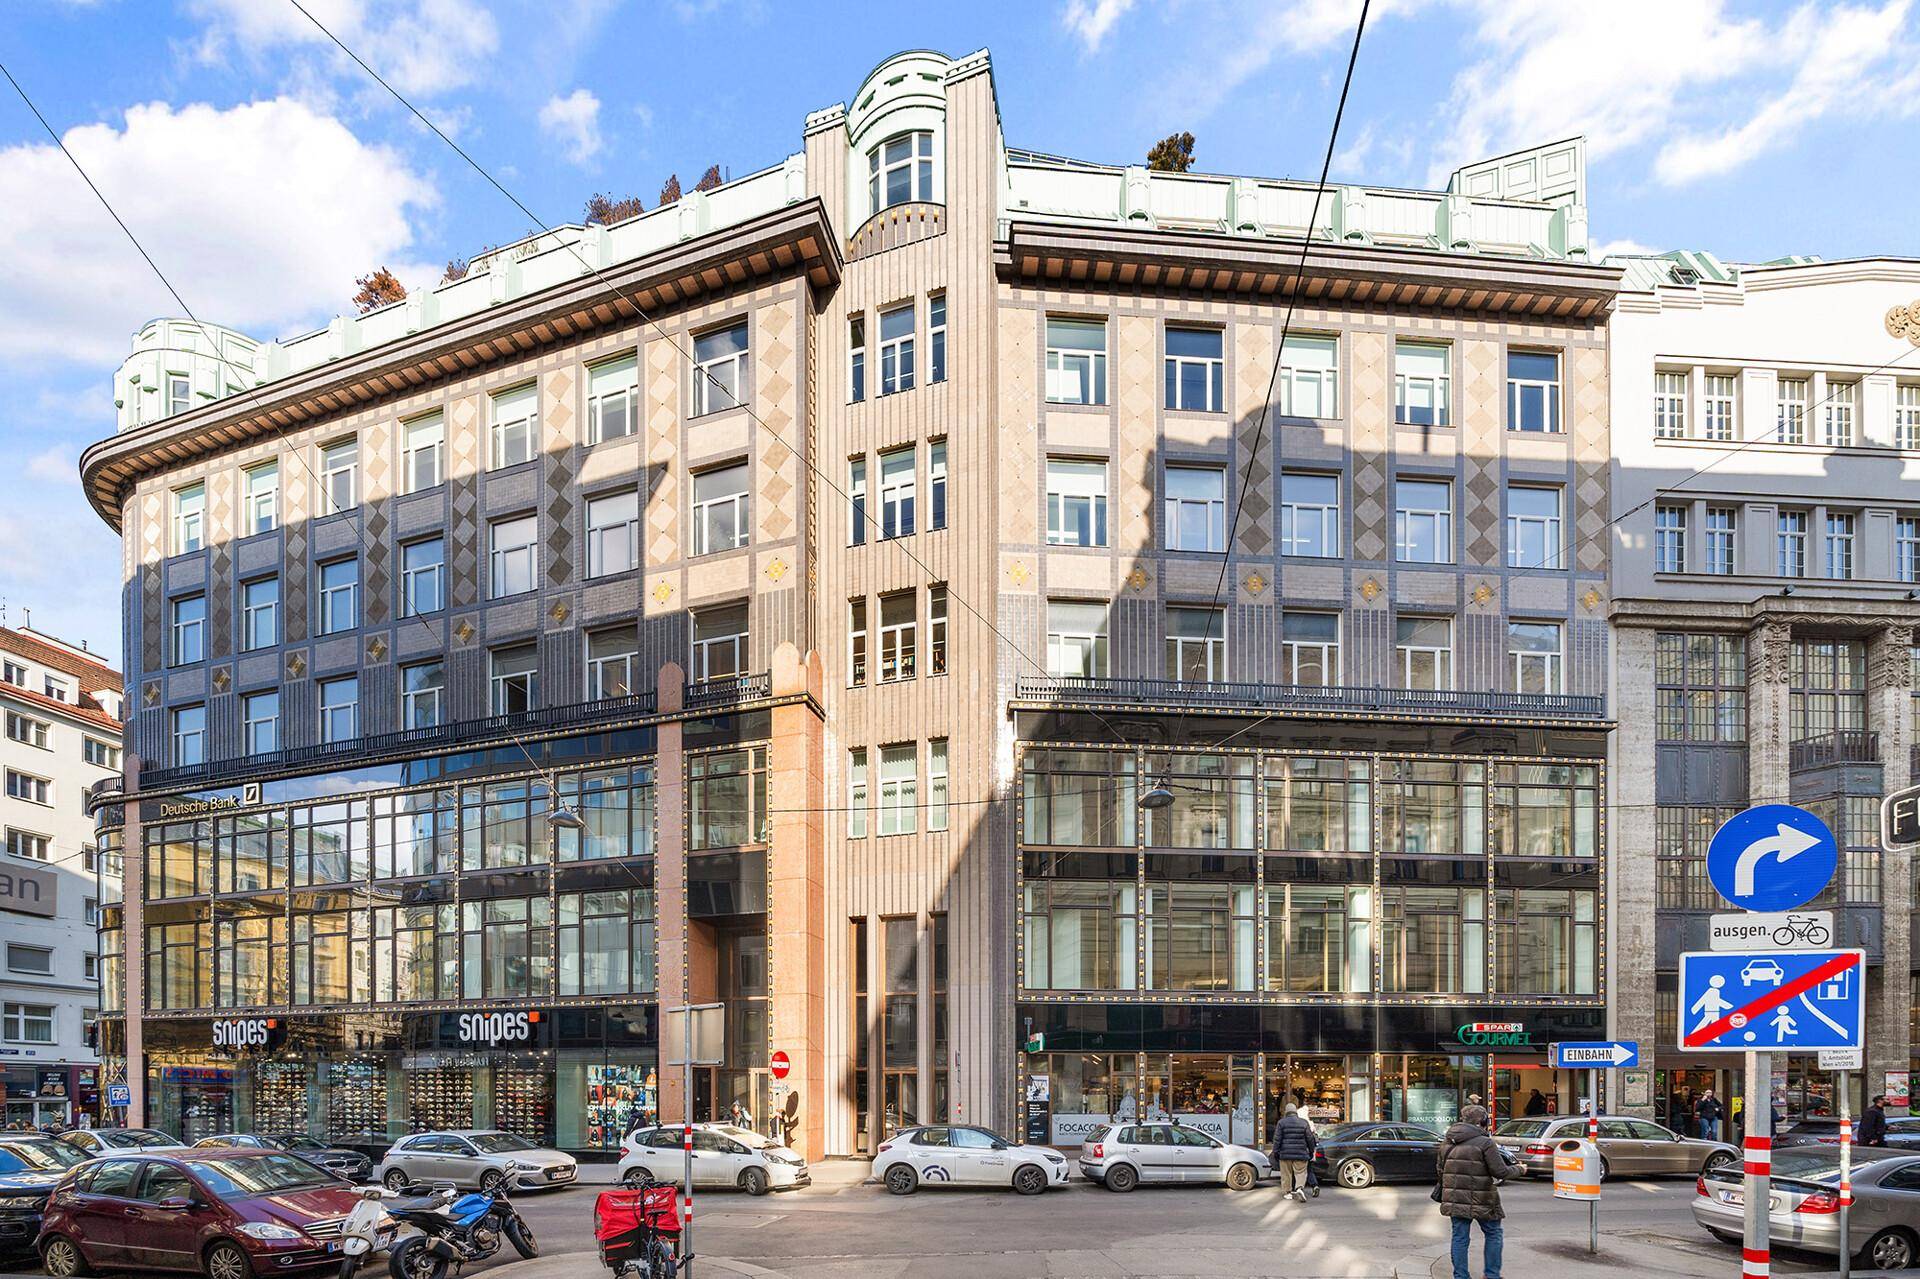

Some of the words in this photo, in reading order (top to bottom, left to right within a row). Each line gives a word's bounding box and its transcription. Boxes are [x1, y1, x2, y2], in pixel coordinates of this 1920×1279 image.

[160, 800, 208, 816] Deutsche
[210, 794, 238, 810] Bank
[1893, 797, 1920, 835] F
[1713, 925, 1771, 940] ausgen.
[212, 1019, 268, 1050] snipes
[459, 1011, 529, 1047] snipes
[1457, 1024, 1531, 1045] GOURMET
[1483, 1024, 1511, 1032] SPAR
[1567, 1049, 1613, 1061] EINBAHN
